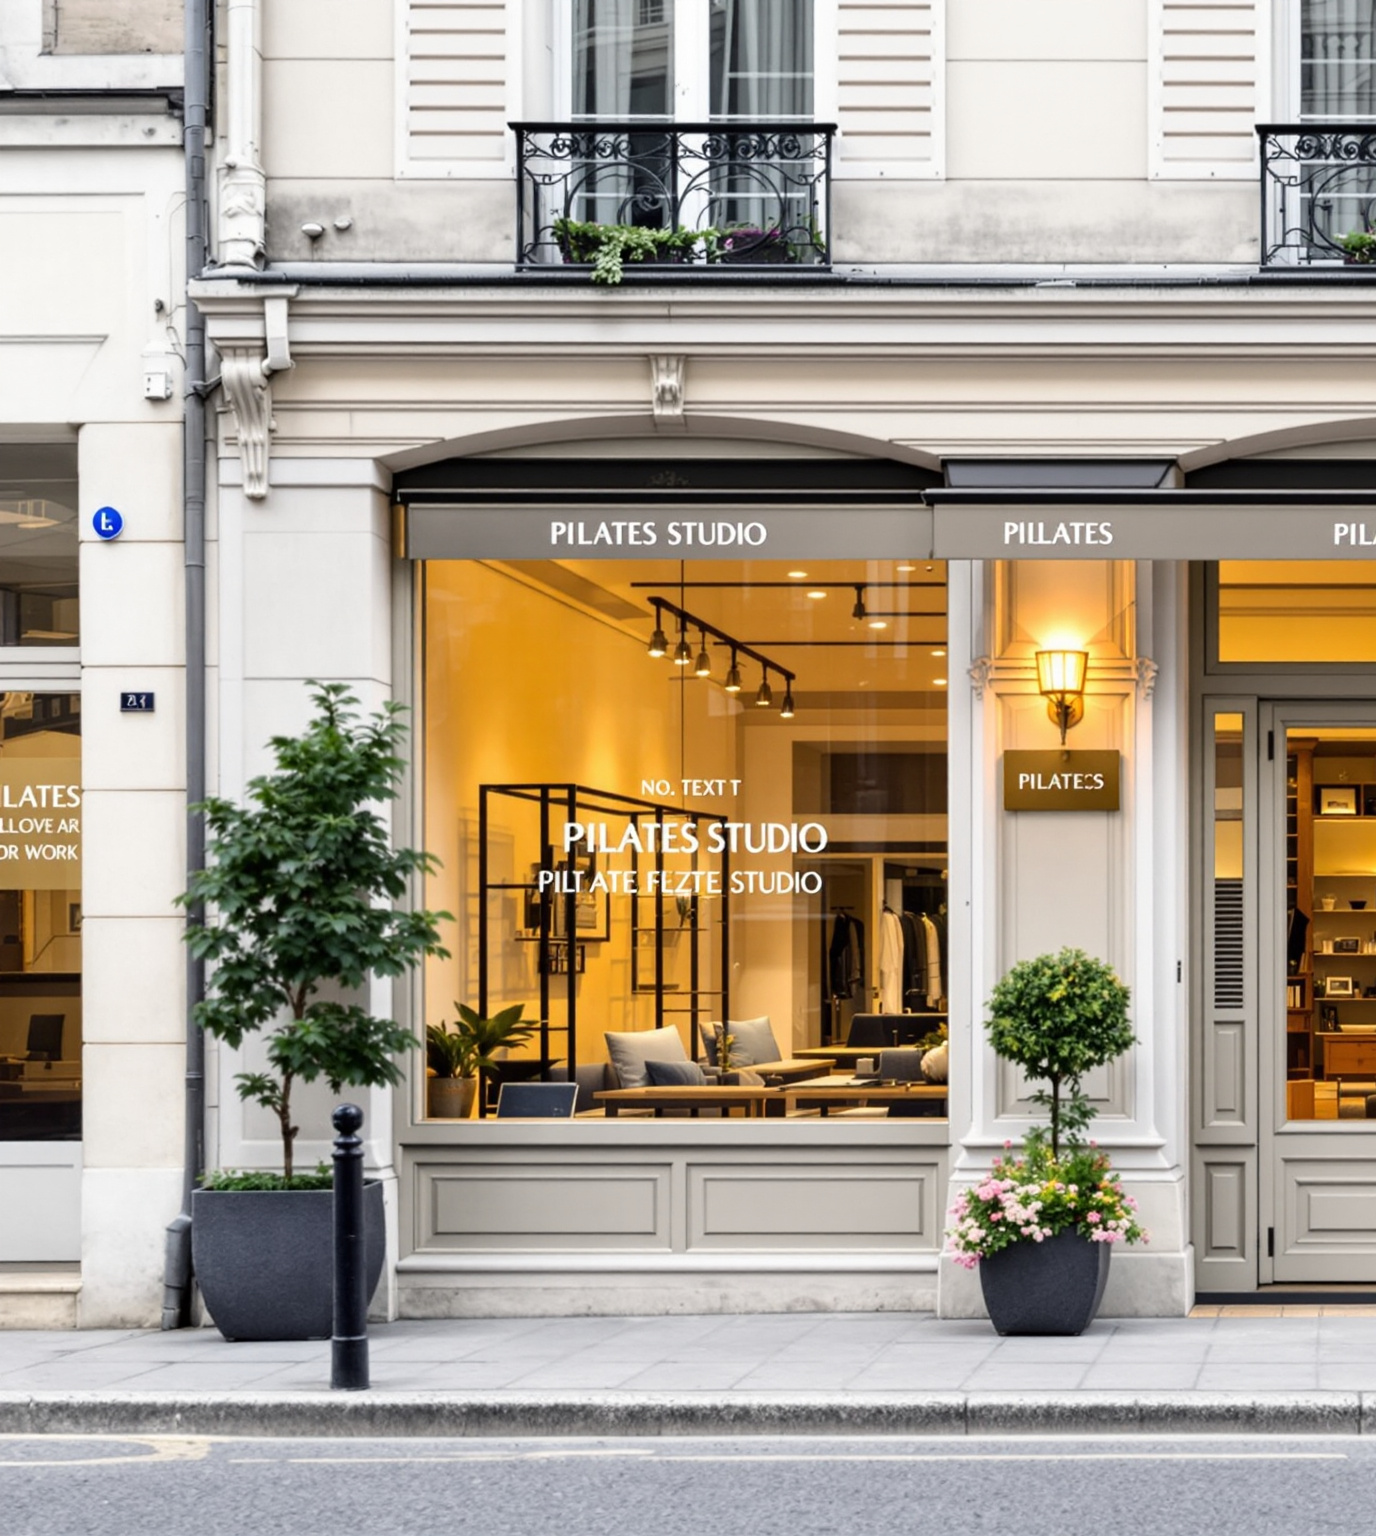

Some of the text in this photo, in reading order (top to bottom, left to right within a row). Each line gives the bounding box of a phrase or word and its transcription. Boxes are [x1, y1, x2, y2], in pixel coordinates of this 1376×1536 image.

[551, 521, 767, 546] PILATES STUDIO
[0, 784, 81, 808] LATES
[641, 779, 676, 797] NO.
[681, 779, 727, 797] TEXT
[563, 821, 829, 855] PILATES STUDIO
[24, 844, 79, 860] WORK
[730, 870, 823, 894] STUDIO
